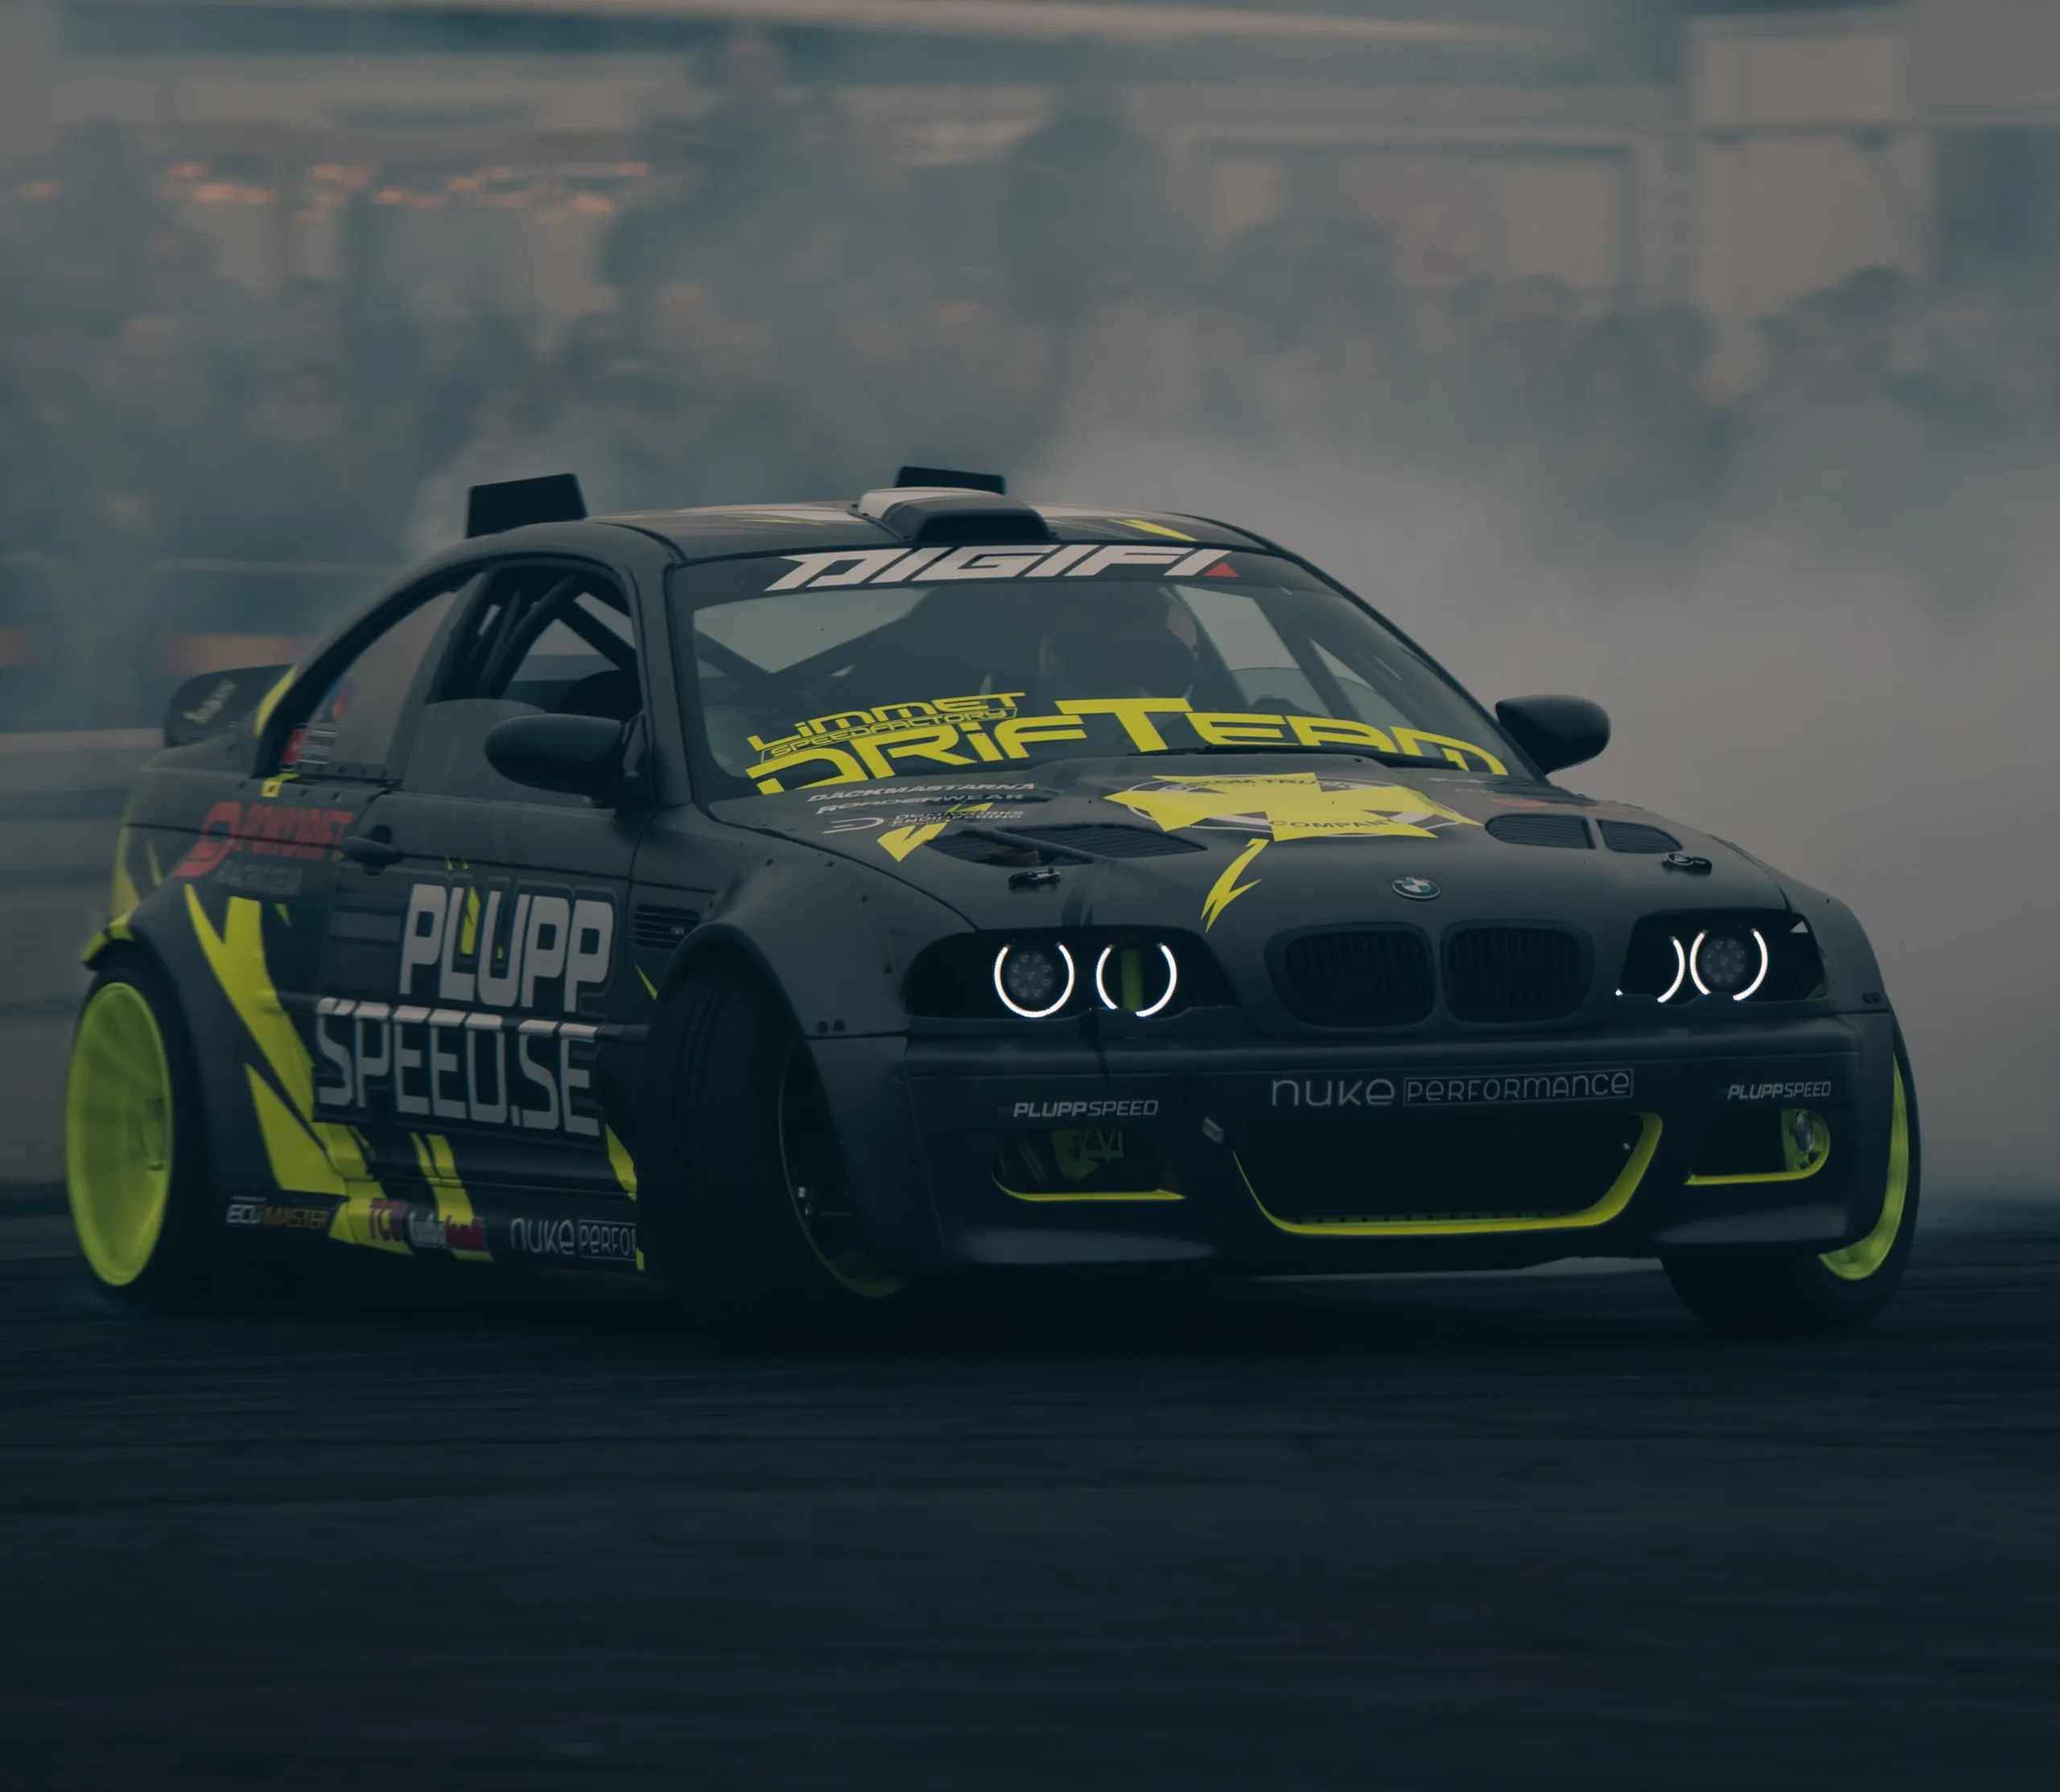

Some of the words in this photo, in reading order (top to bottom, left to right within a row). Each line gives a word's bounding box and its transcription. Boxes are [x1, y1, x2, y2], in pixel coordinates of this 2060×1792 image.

[770, 708, 1007, 758] SPEEDFACTORY
[399, 884, 613, 1012] PLUPP
[317, 998, 600, 1137] SPEED.SE
[1013, 1100, 1159, 1118] PLUPPSPEED
[1728, 1081, 1831, 1101] PLUPPSPEED
[579, 1223, 637, 1257] PERFO
